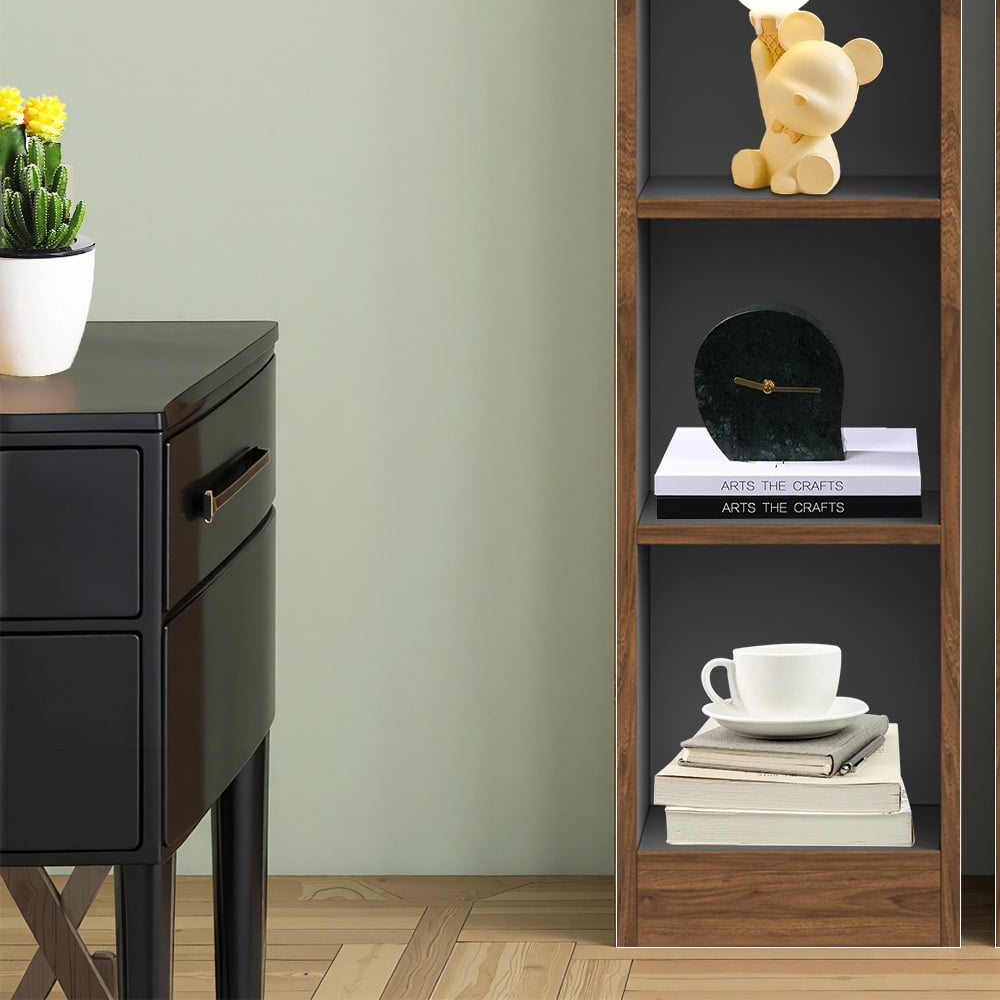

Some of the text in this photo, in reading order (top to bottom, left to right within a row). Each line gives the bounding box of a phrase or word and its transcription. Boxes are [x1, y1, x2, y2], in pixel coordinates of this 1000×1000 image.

[720, 480, 844, 491] ARTS THE CRAFTS
[721, 502, 845, 513] ARTS THE CRAFTS
